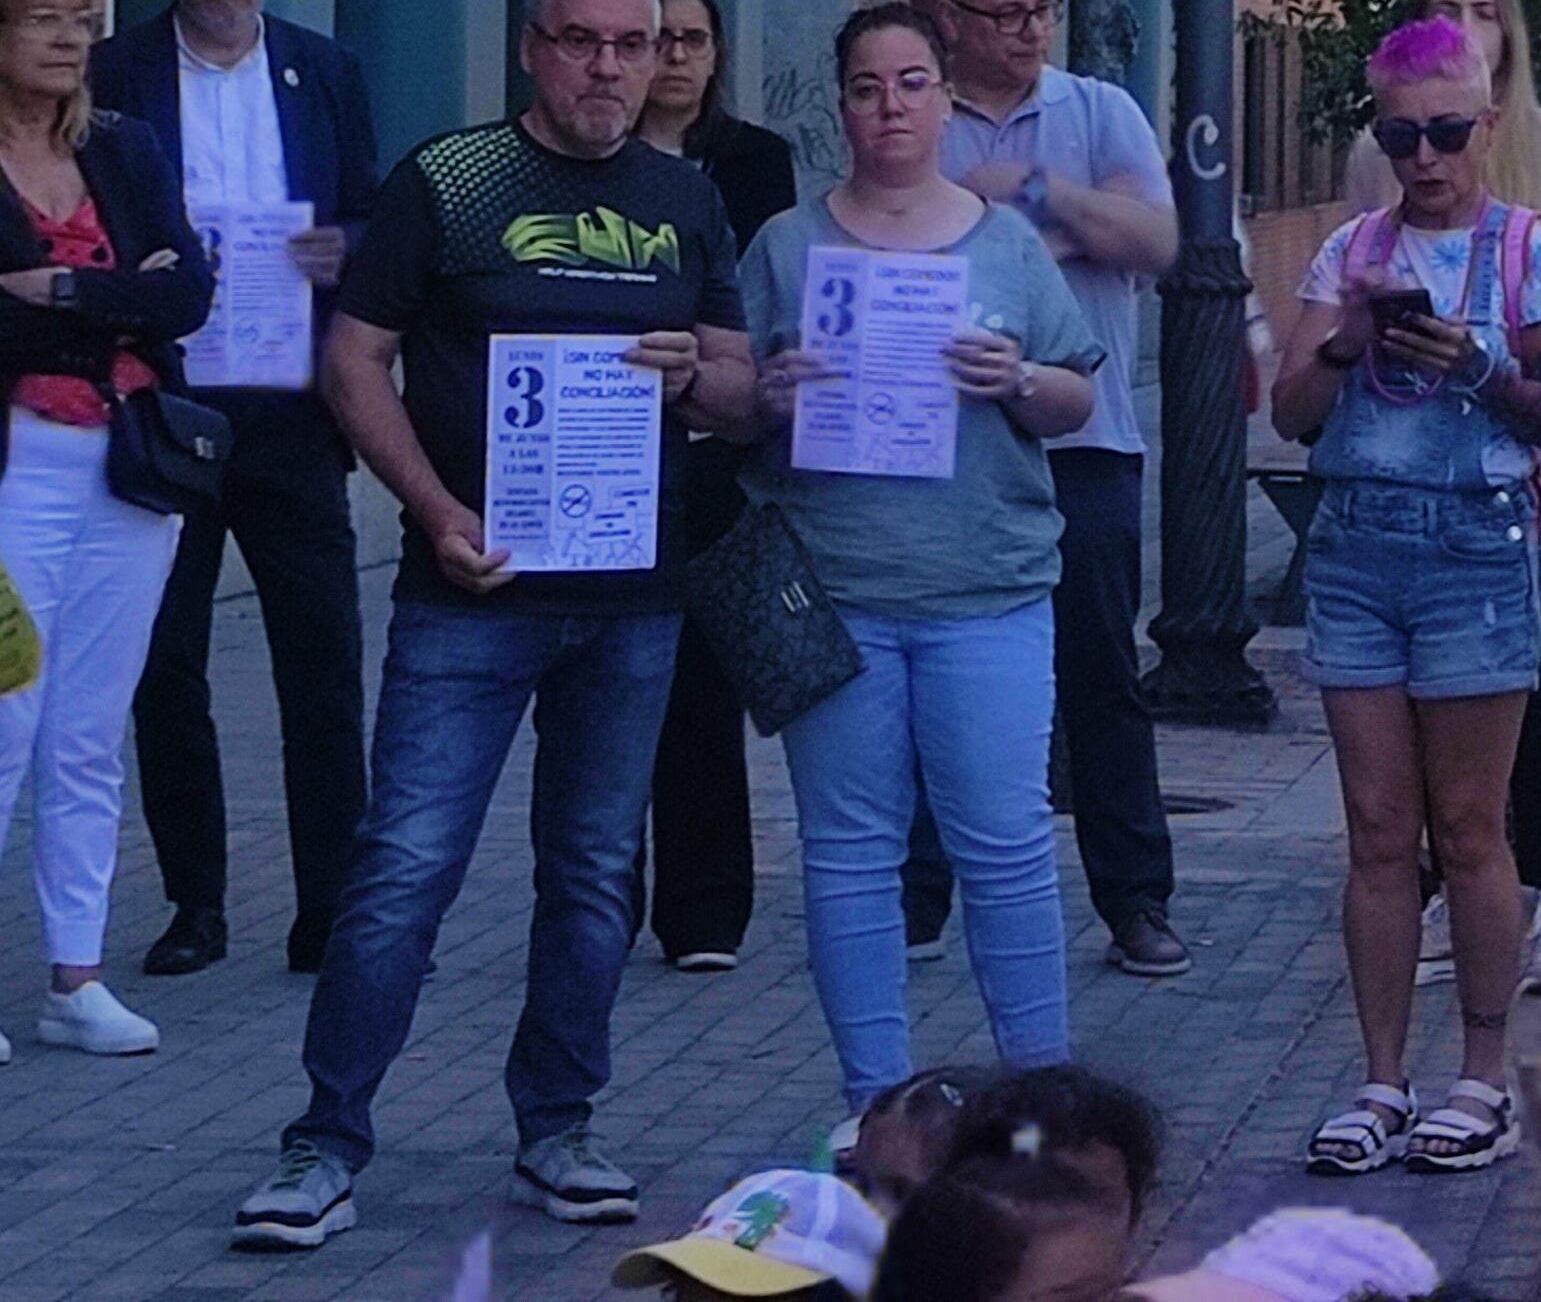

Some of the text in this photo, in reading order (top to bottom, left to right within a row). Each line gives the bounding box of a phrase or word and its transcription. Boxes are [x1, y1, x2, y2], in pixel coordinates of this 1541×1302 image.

[818, 276, 856, 337] 3
[563, 349, 589, 364] ¡SIN
[584, 369, 633, 381] NO HAY
[504, 366, 545, 429] 3
